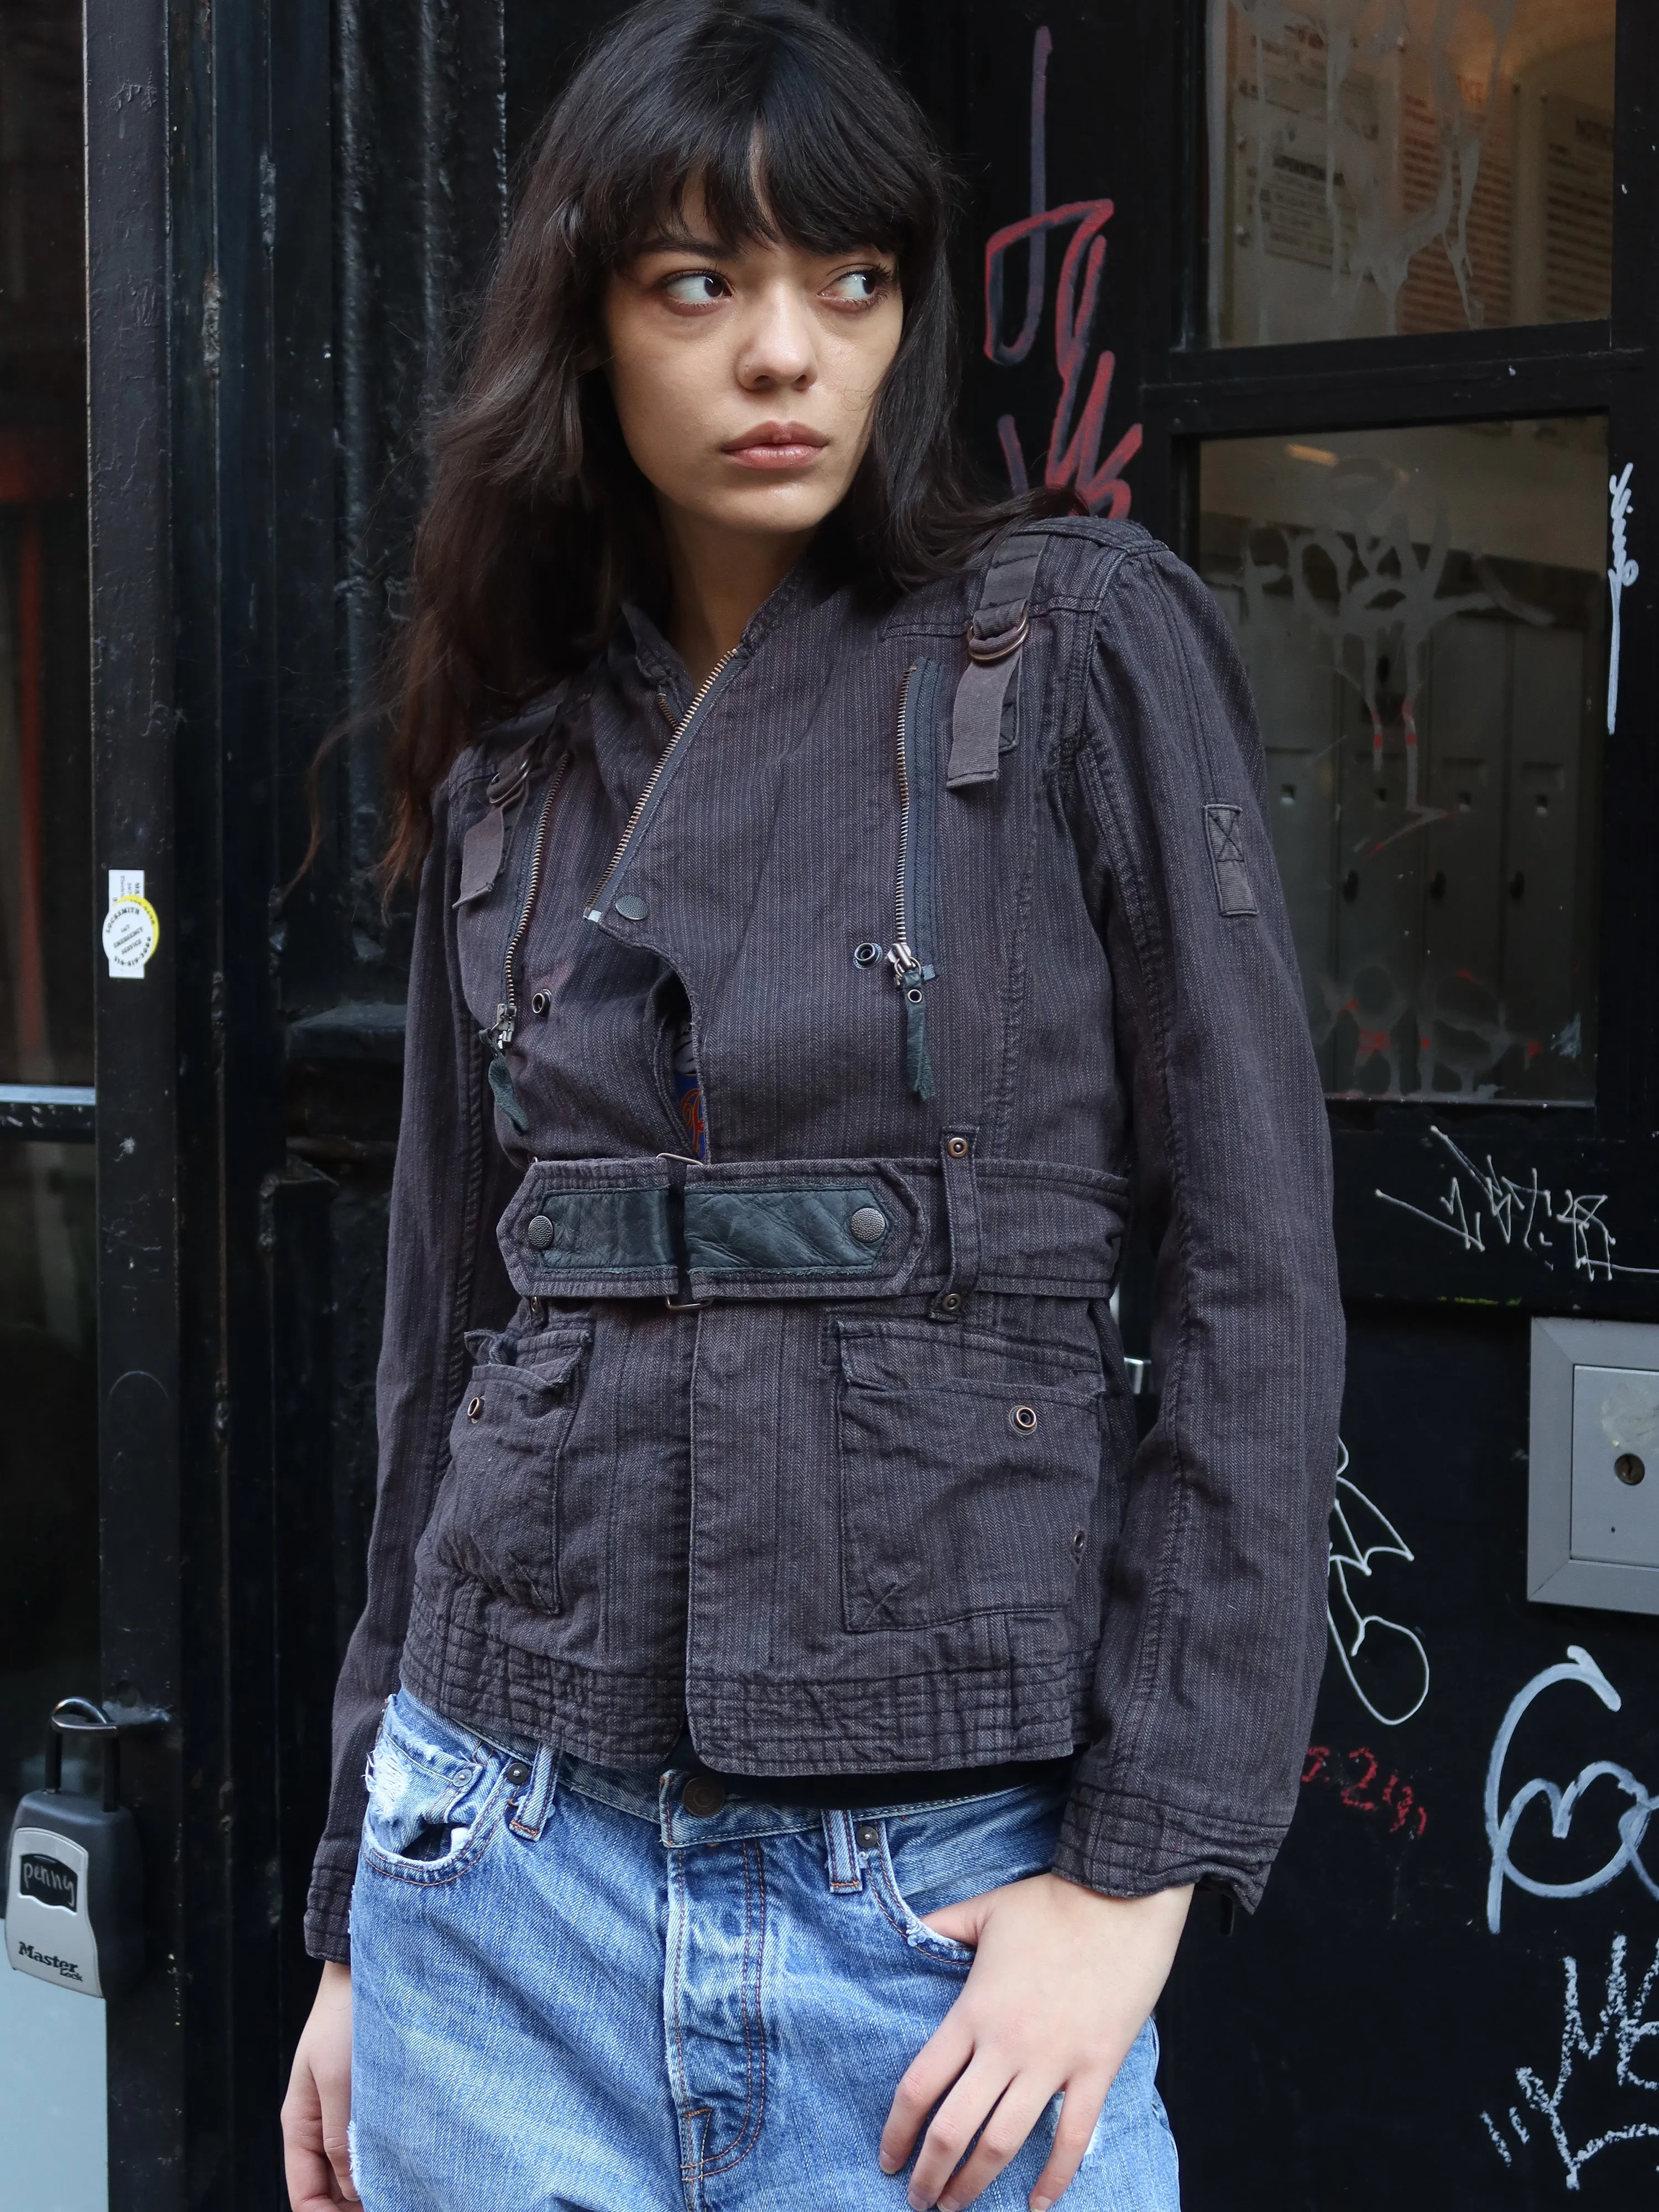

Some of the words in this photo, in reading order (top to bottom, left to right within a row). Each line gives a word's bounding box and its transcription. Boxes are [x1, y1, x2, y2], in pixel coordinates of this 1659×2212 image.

[105, 906, 140, 933] LOCKSMITH
[113, 925, 144, 948] EMERGENCY
[121, 938, 142, 955] SERVICE
[18, 1941, 79, 1973] Master
[59, 1968, 84, 1982] Lock
